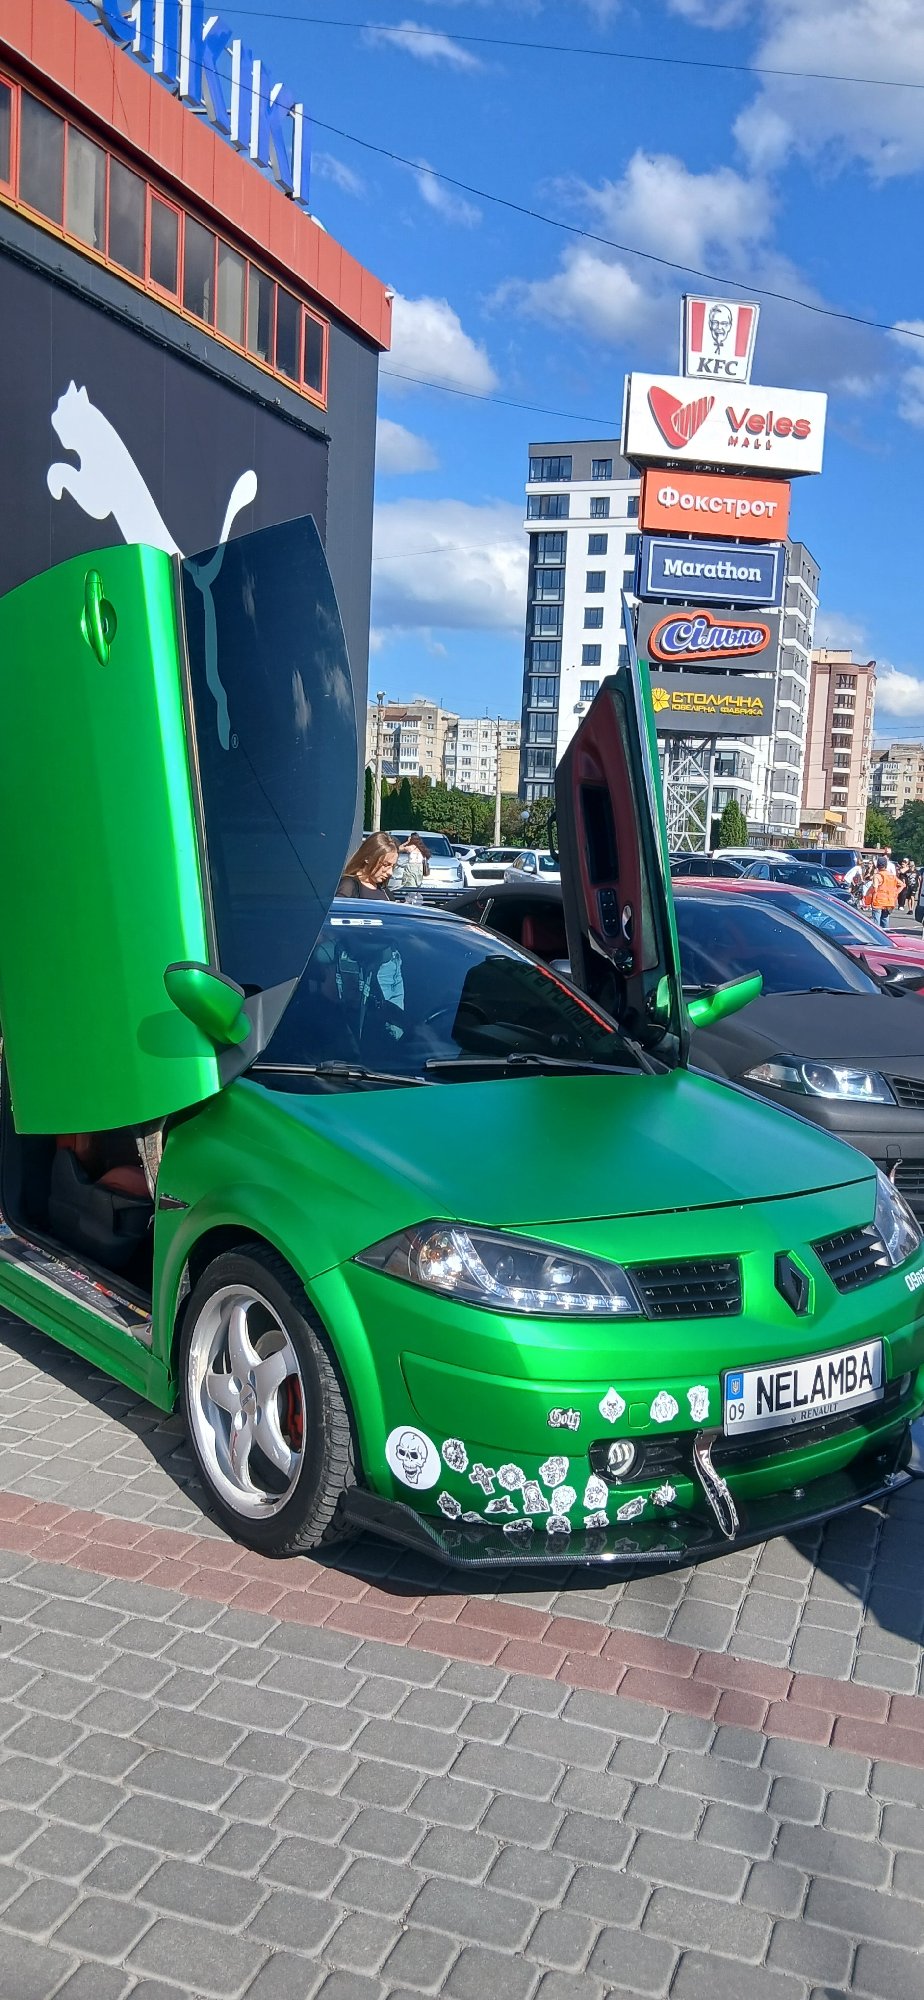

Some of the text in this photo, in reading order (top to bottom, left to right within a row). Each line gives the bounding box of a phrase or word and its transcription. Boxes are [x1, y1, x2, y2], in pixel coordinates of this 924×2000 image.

[697, 357, 739, 376] KFC
[725, 406, 811, 439] Veles
[728, 435, 772, 450] MALL
[657, 486, 778, 519] Фокстрот
[663, 558, 762, 582] Marathon
[662, 618, 764, 652] Сільпо
[672, 691, 764, 708] СТОЛИЧНА
[671, 704, 764, 716] ЮВЕЛІРНА ФАБРИКА
[756, 1351, 873, 1415] NELAMBA
[729, 1403, 745, 1421] 09
[801, 1403, 839, 1421] RENAULT
